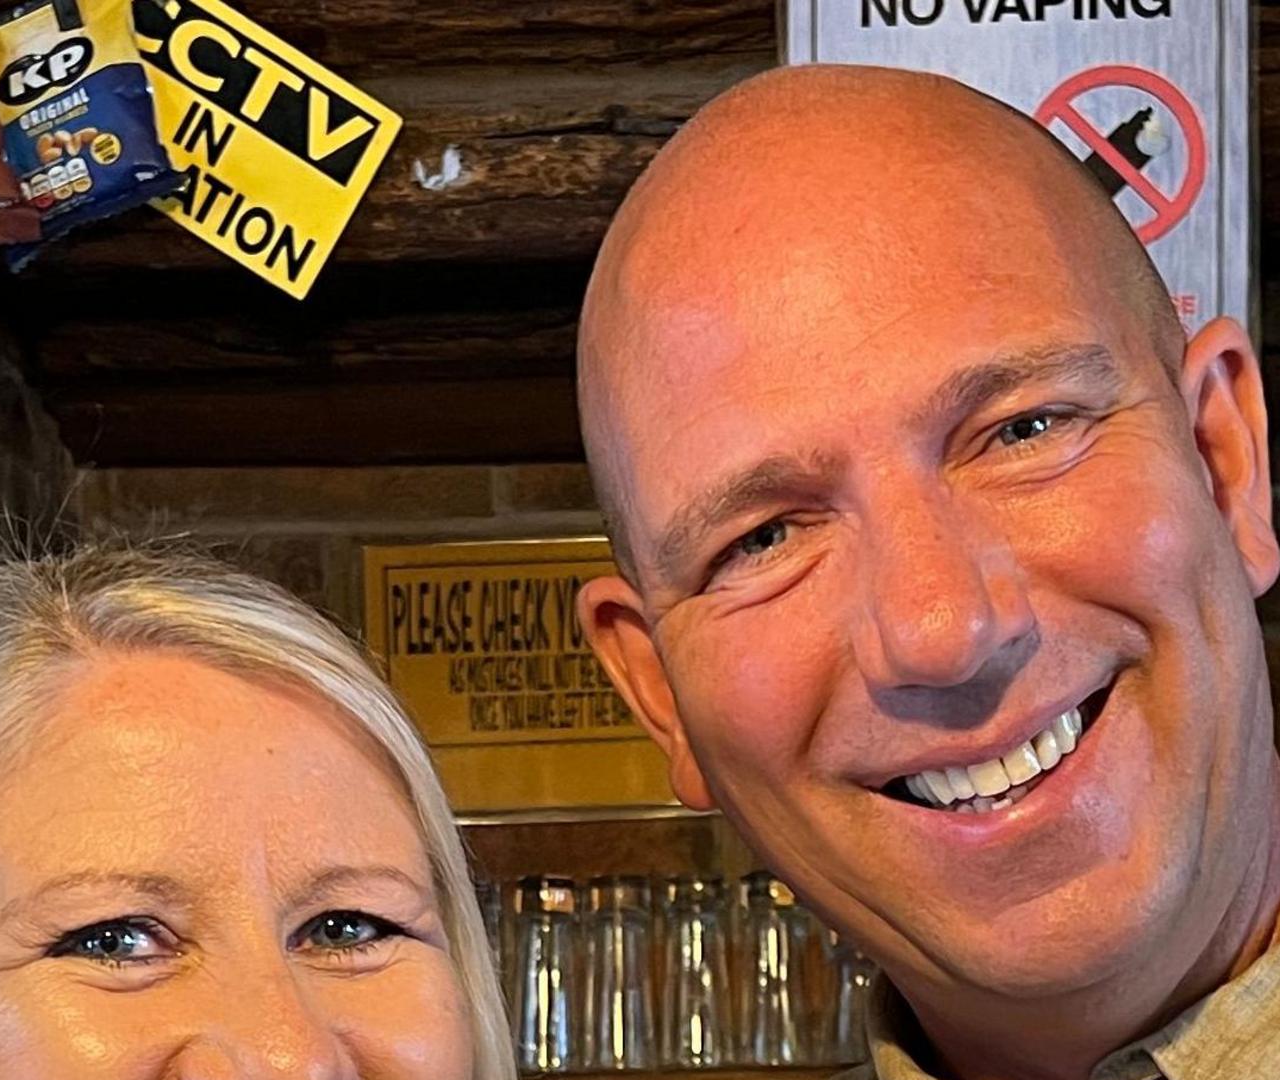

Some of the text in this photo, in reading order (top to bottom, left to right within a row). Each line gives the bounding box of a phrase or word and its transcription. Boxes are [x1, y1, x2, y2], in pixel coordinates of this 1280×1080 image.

[9, 44, 86, 97] KP
[20, 88, 91, 131] ORIGINAL
[173, 101, 236, 167] IN
[176, 164, 317, 283] ATION
[391, 579, 475, 655] PLEASE
[482, 577, 551, 652] CHECK
